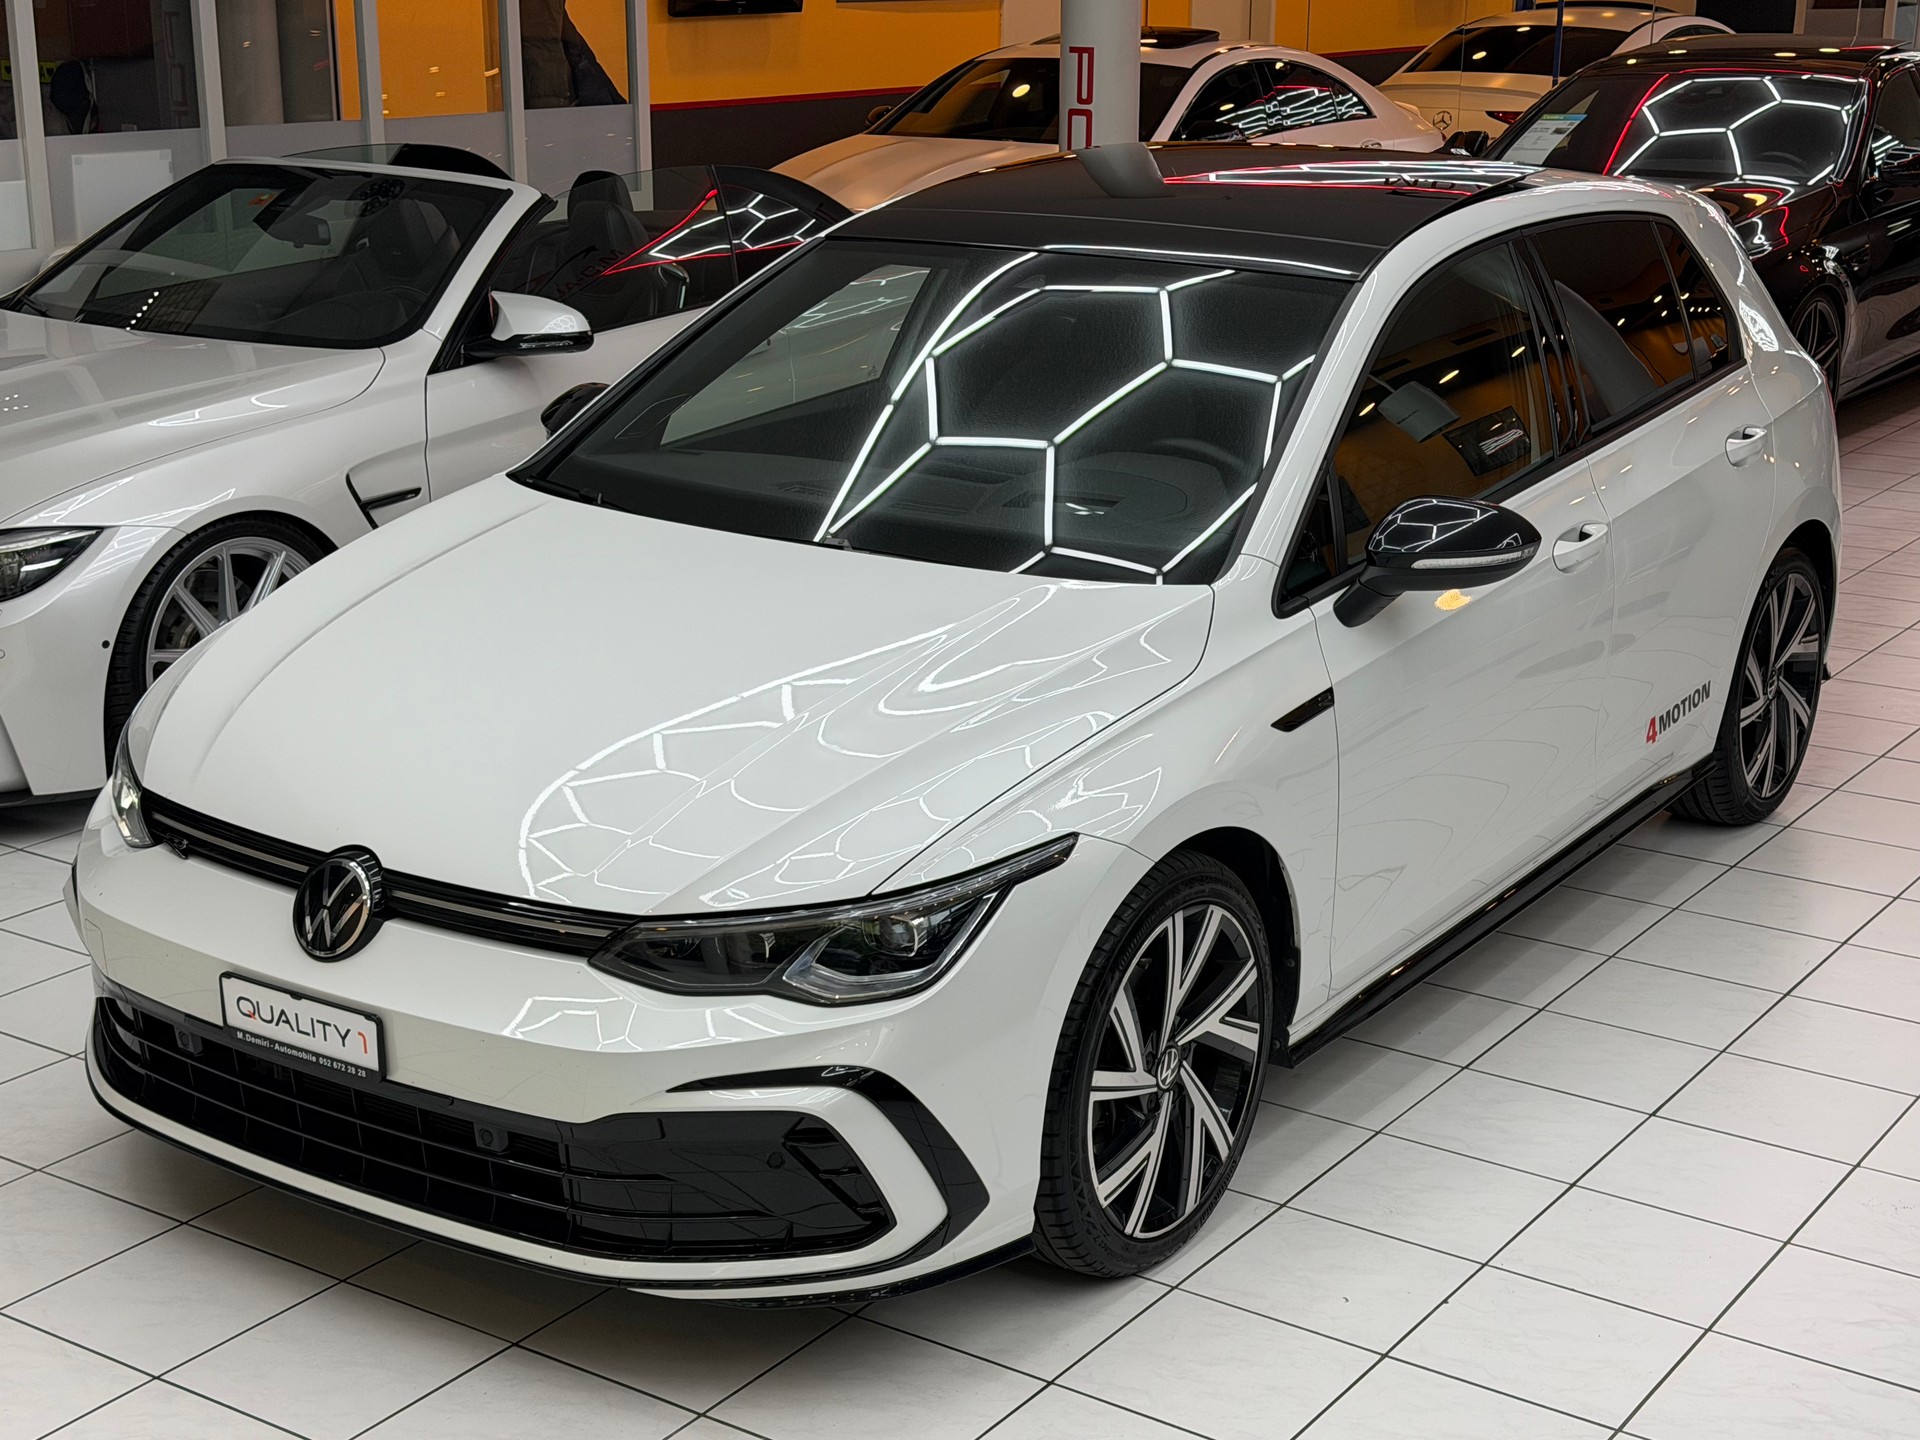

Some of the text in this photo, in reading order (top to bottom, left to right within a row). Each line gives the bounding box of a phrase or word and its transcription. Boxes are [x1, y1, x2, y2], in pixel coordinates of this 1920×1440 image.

[236, 996, 352, 1048] QUALITY
[274, 1043, 317, 1063] Automobile
[318, 1057, 332, 1068] 052
[333, 1062, 346, 1072] 672
[347, 1066, 356, 1075] 28
[357, 1069, 367, 1078] 28
